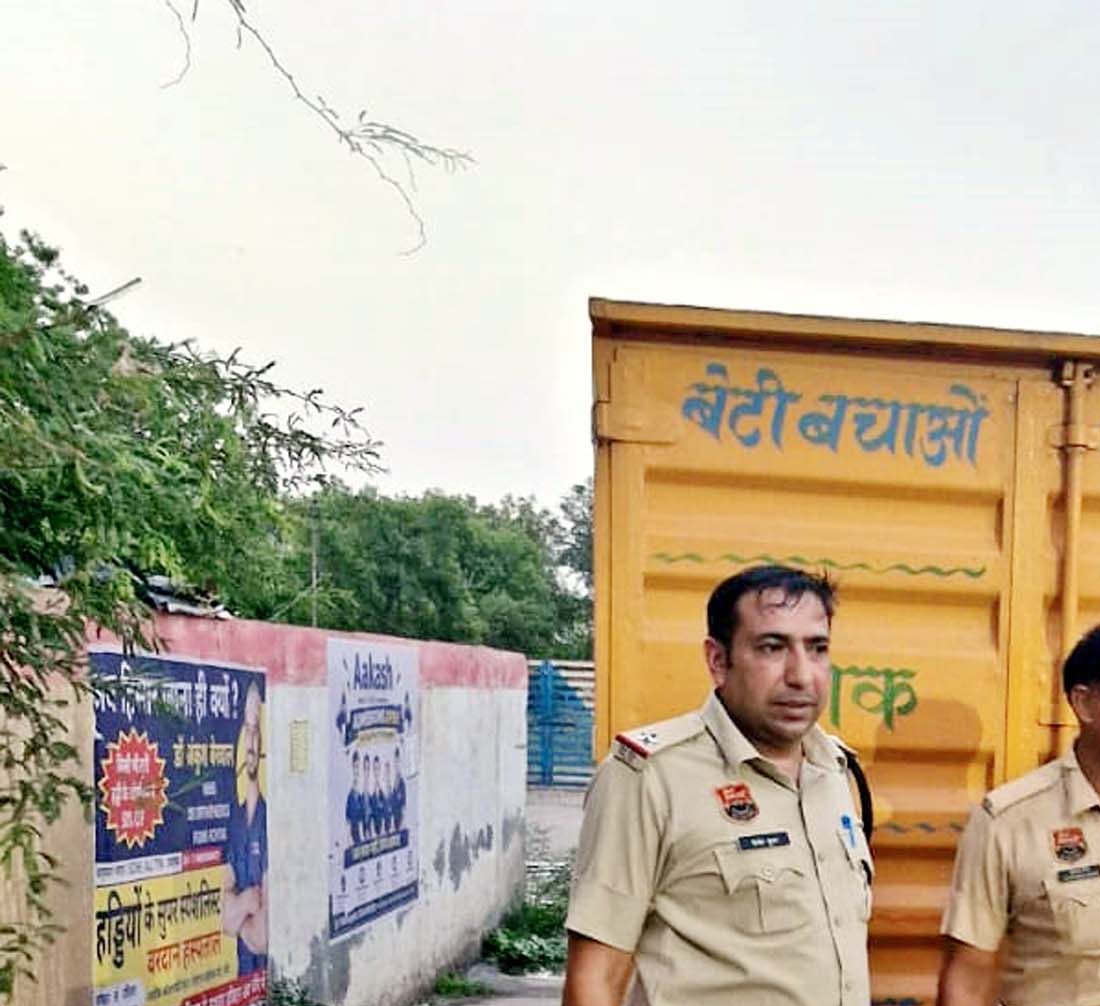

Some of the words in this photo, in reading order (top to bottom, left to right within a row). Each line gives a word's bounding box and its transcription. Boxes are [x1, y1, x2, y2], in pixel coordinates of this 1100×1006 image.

[682, 362, 802, 450] बेटी
[353, 653, 394, 690] Aakash
[830, 664, 917, 733] ाक
